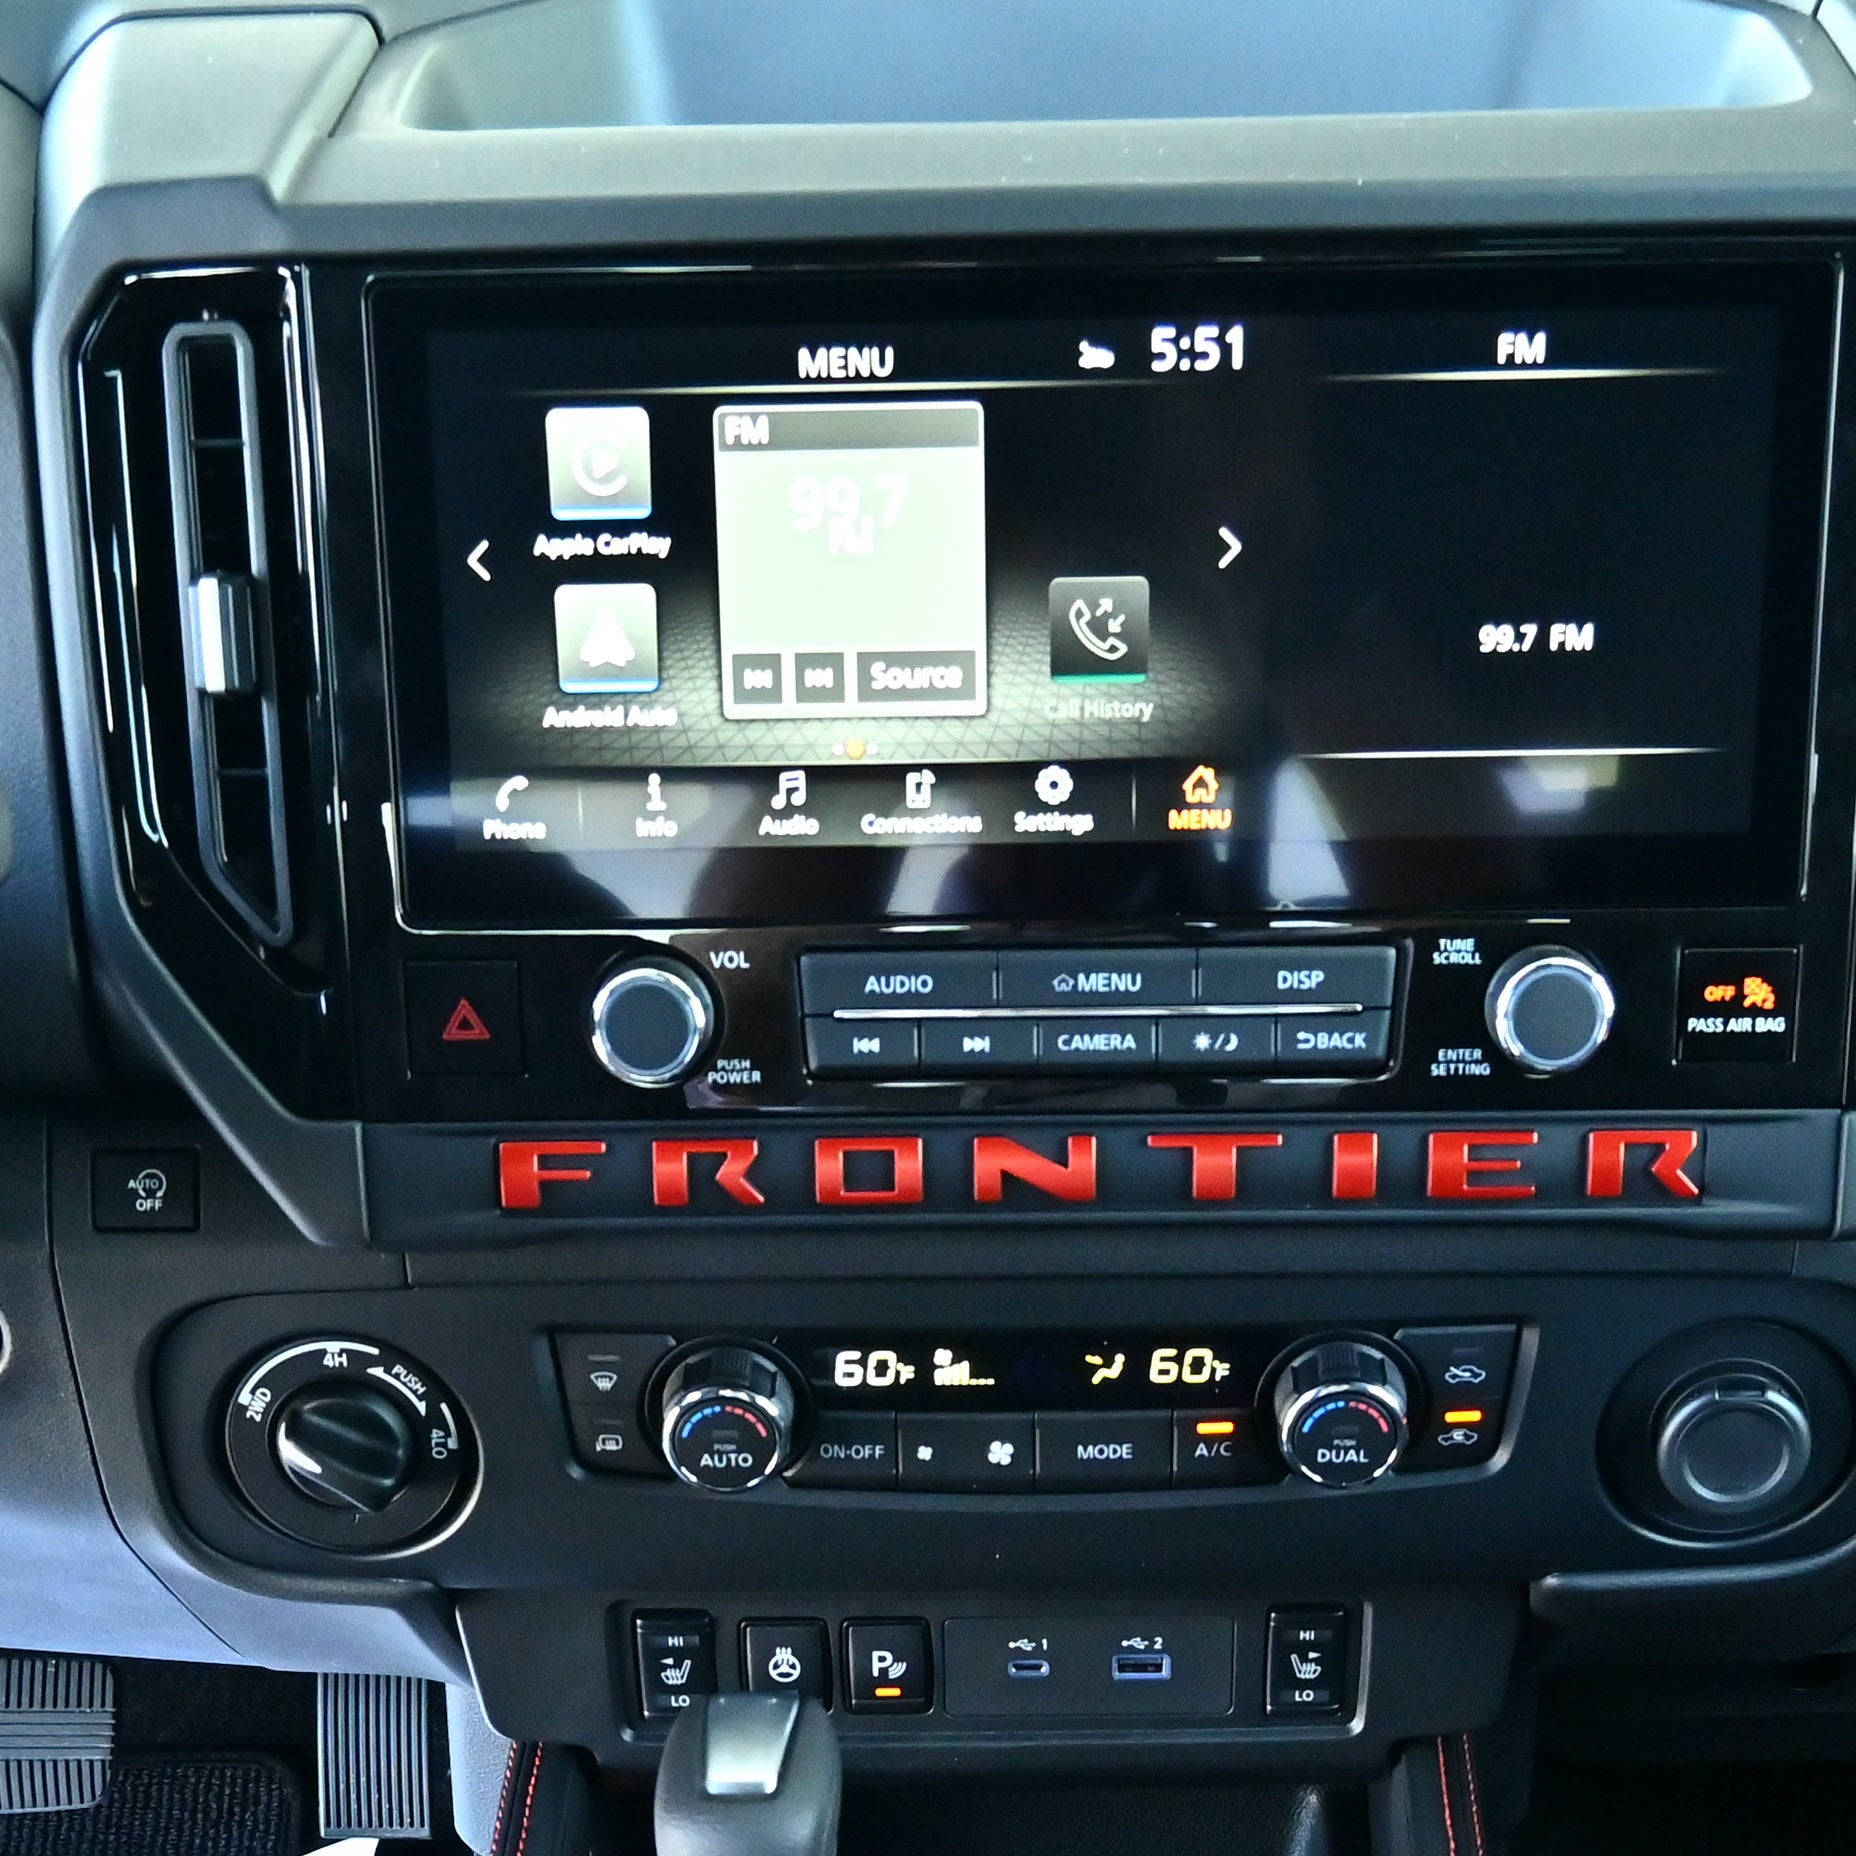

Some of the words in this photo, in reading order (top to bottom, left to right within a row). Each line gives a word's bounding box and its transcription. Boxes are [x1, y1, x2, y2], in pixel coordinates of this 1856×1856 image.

[1150, 323, 1246, 372] 5:51
[1496, 333, 1547, 365] FM
[798, 347, 894, 378] MENU
[725, 415, 769, 445] FM
[788, 475, 909, 530] 99.7
[533, 533, 593, 560] Apple
[596, 533, 672, 559] CarPlay
[828, 519, 874, 556] FM
[1478, 624, 1538, 654] 99.7
[1549, 624, 1594, 652] FM
[870, 661, 963, 692] Source
[542, 706, 619, 730] Android
[625, 705, 678, 728] Auto
[1045, 698, 1079, 721] Call
[1083, 697, 1154, 723] History
[635, 817, 678, 838] Info
[759, 814, 819, 836] Audio
[860, 811, 982, 835] Connections
[1013, 810, 1094, 836] Settings
[1168, 809, 1232, 830] MENU
[483, 818, 546, 841] Phone
[1438, 939, 1475, 954] TUNE
[710, 951, 750, 969] VOL
[1432, 952, 1481, 966] SCROLL
[865, 975, 933, 994] AUDIO
[1077, 971, 1142, 993] MENU
[1276, 970, 1325, 990] DISP
[1704, 984, 1735, 1002] OFF
[1687, 1017, 1724, 1033] PASS
[1727, 1017, 1751, 1033] AIR
[1754, 1017, 1785, 1034] BAG
[1057, 1032, 1137, 1052] CAMERA
[1317, 1031, 1366, 1050] BACK
[717, 1059, 751, 1070] PUSH
[1437, 1049, 1482, 1062] ENTER
[708, 1069, 761, 1084] POWER
[1429, 1062, 1491, 1077] SETTING
[499, 1130, 1700, 1208] FRONTIER
[128, 1179, 158, 1189] AUTO
[136, 1200, 162, 1211] OFF
[323, 1353, 348, 1368] 4H
[391, 1364, 427, 1395] PUSH
[246, 1387, 272, 1422] 2WD
[430, 1428, 447, 1460] 4LO
[1077, 1443, 1133, 1460] MODE
[1194, 1441, 1232, 1458] A/C
[700, 1453, 753, 1469] AUTO
[1317, 1448, 1369, 1464] DUAL
[668, 1636, 684, 1646] HI
[1042, 1639, 1048, 1650] 1
[1154, 1637, 1163, 1649] 2
[1299, 1630, 1315, 1641] HI
[671, 1695, 690, 1707] LO
[1295, 1690, 1314, 1701] LO
